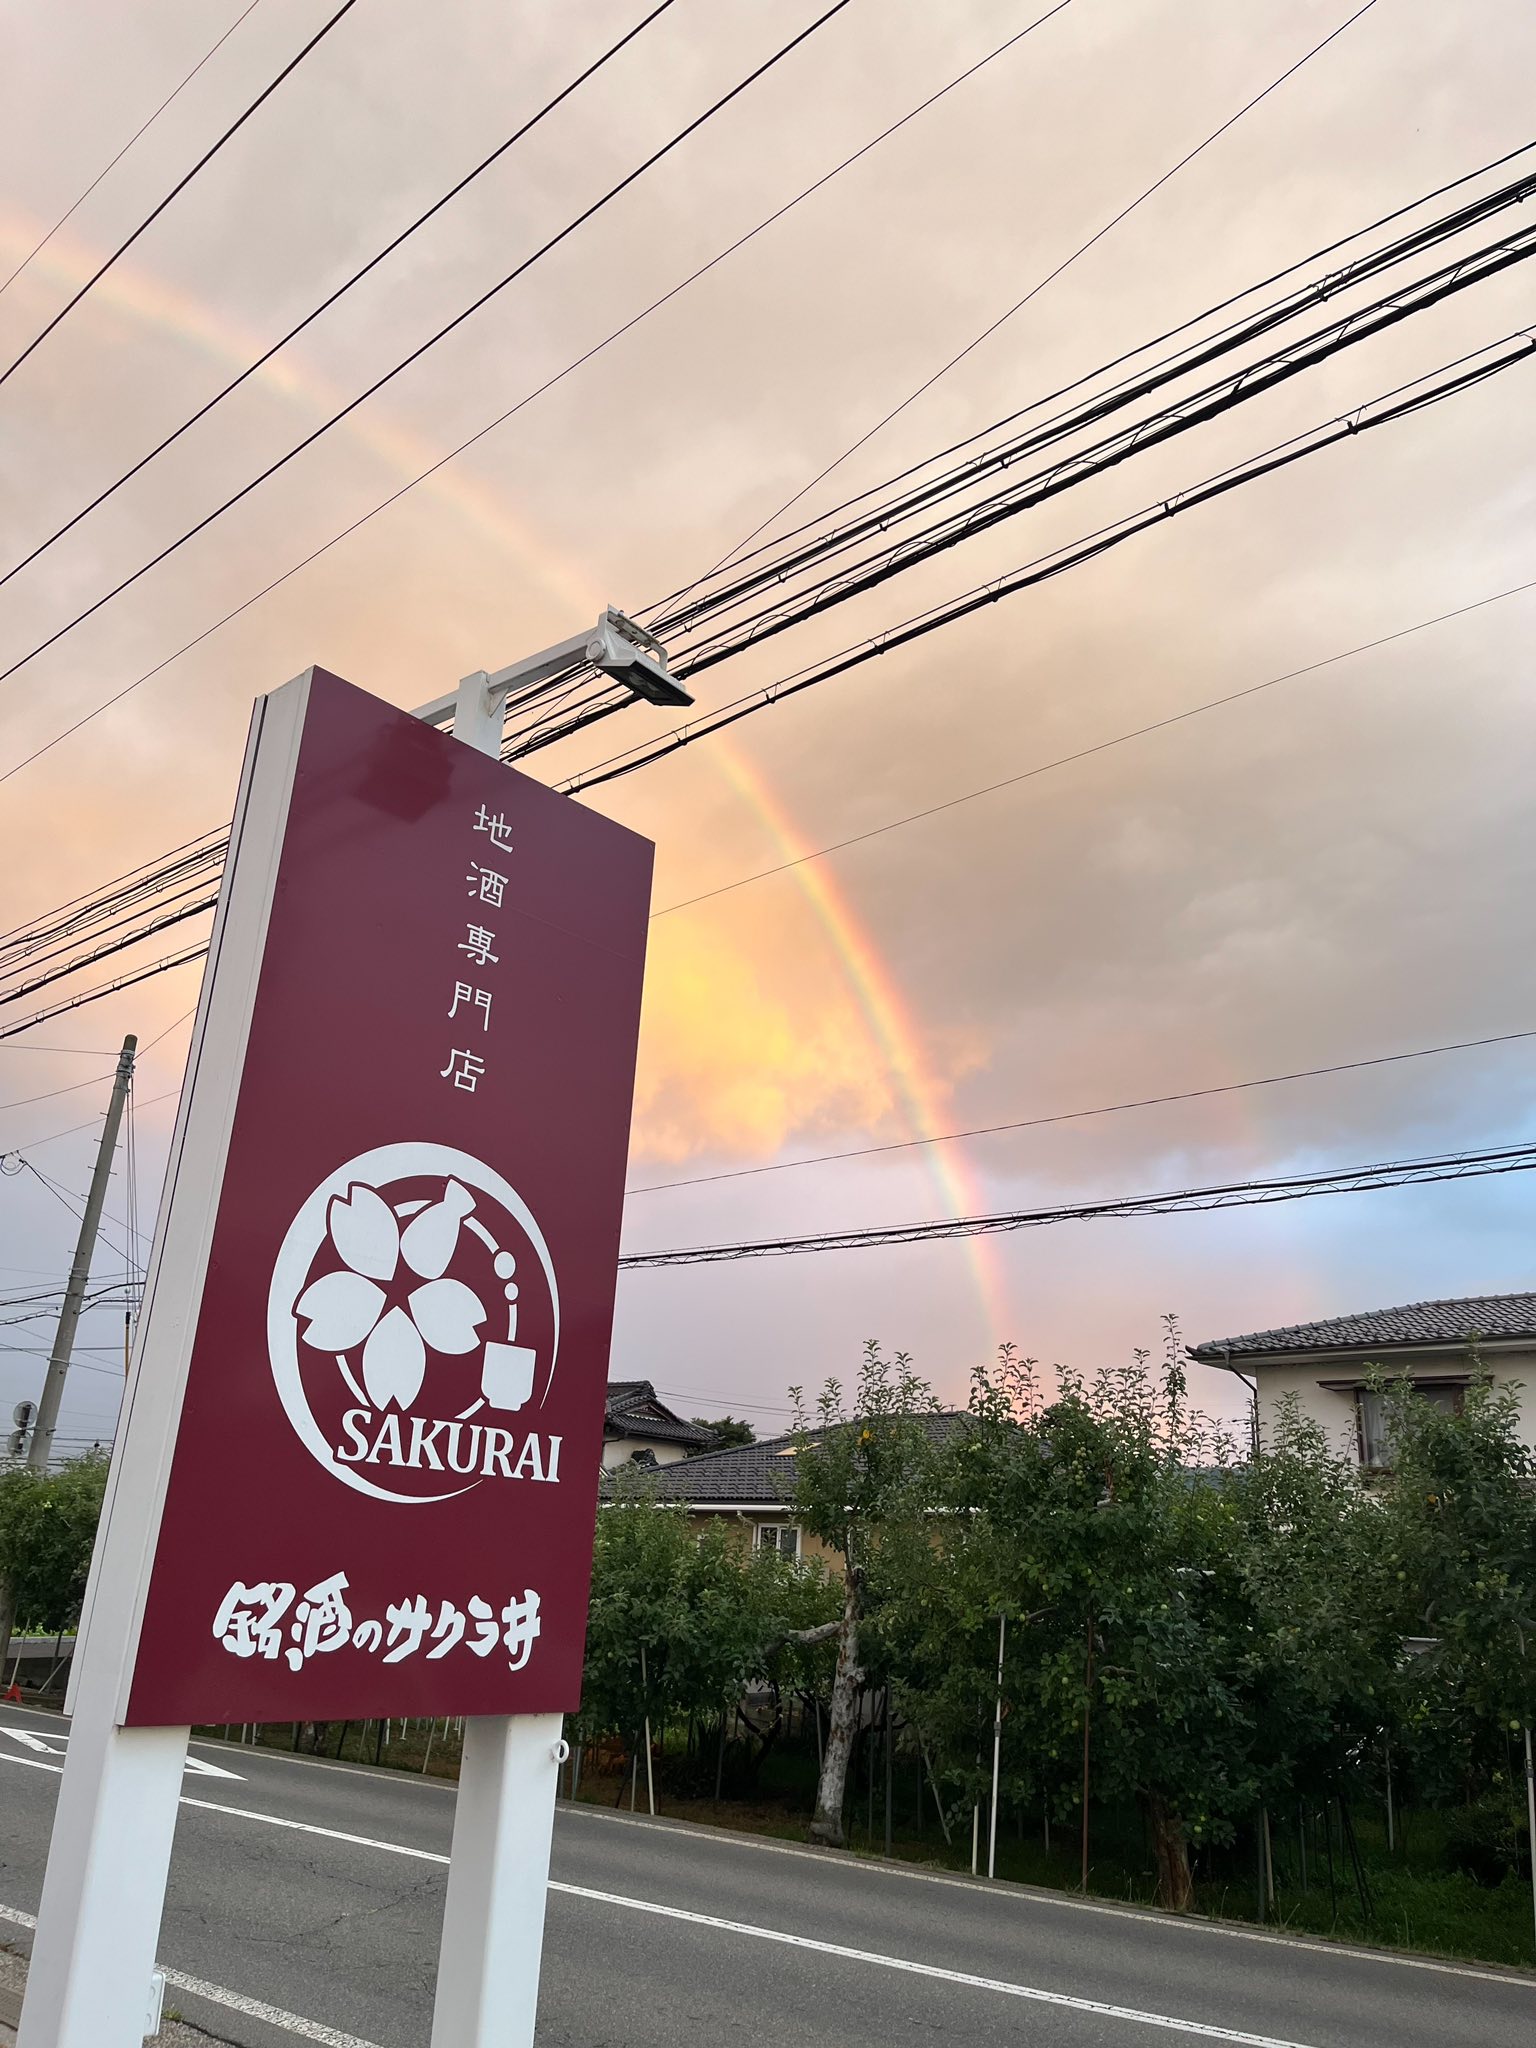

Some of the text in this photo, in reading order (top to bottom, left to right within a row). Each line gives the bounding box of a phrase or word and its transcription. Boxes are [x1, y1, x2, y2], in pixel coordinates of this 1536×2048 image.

[439, 803, 514, 1093] 地酒専門店
[337, 1408, 563, 1483] SAKURAI
[212, 1571, 541, 1672] 銘酒のサクラ井
